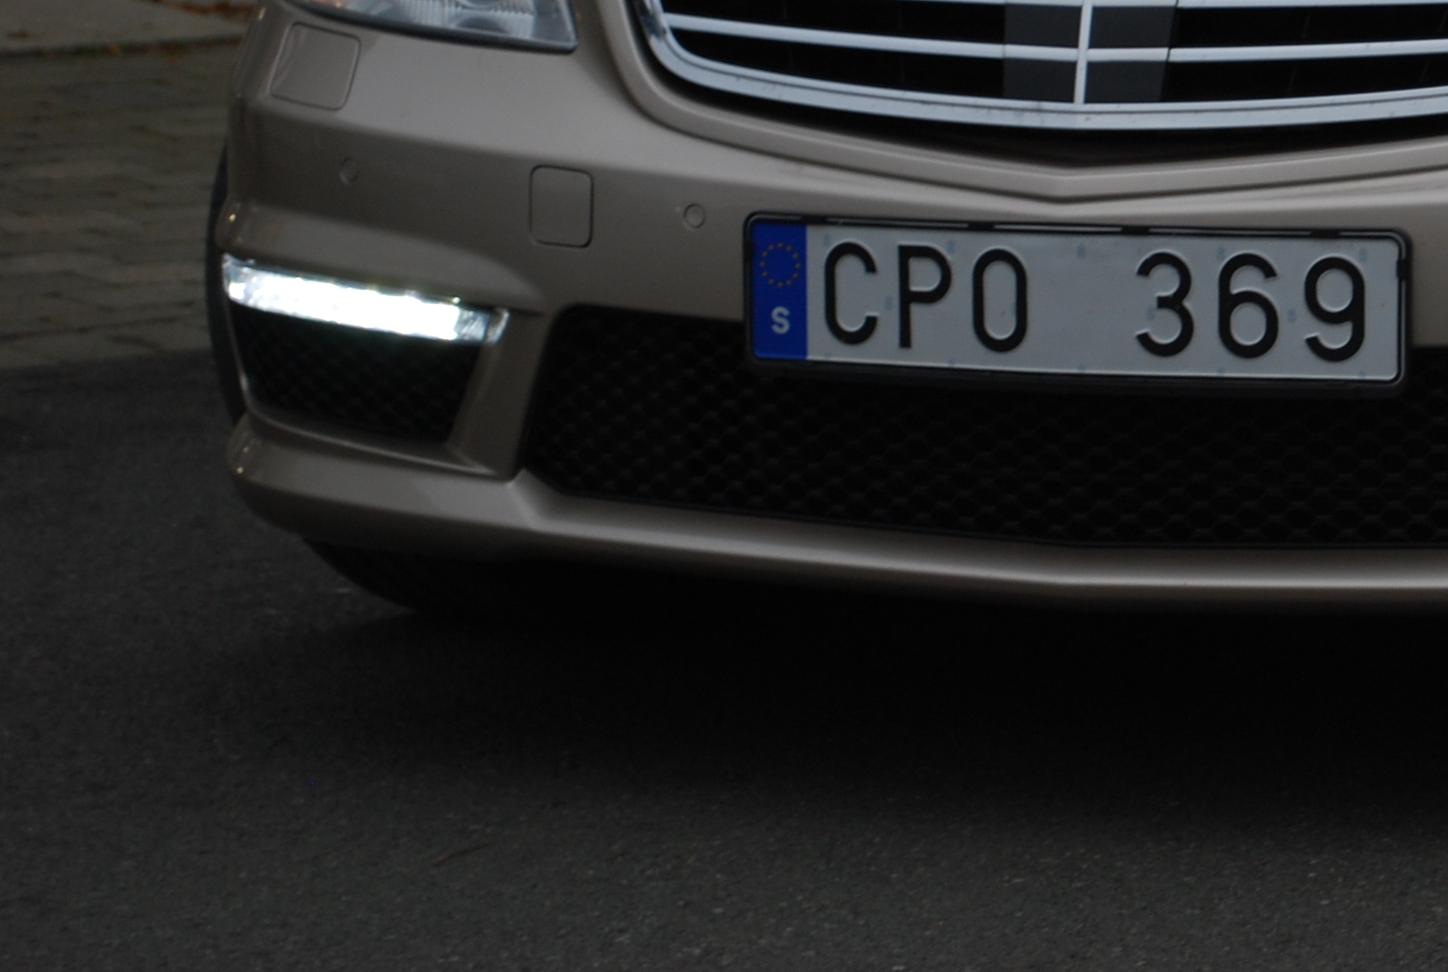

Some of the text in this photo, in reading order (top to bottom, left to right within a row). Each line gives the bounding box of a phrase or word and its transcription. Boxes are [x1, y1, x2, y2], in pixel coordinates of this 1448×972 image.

[771, 306, 790, 335] S
[823, 241, 1366, 363] CPO 369
